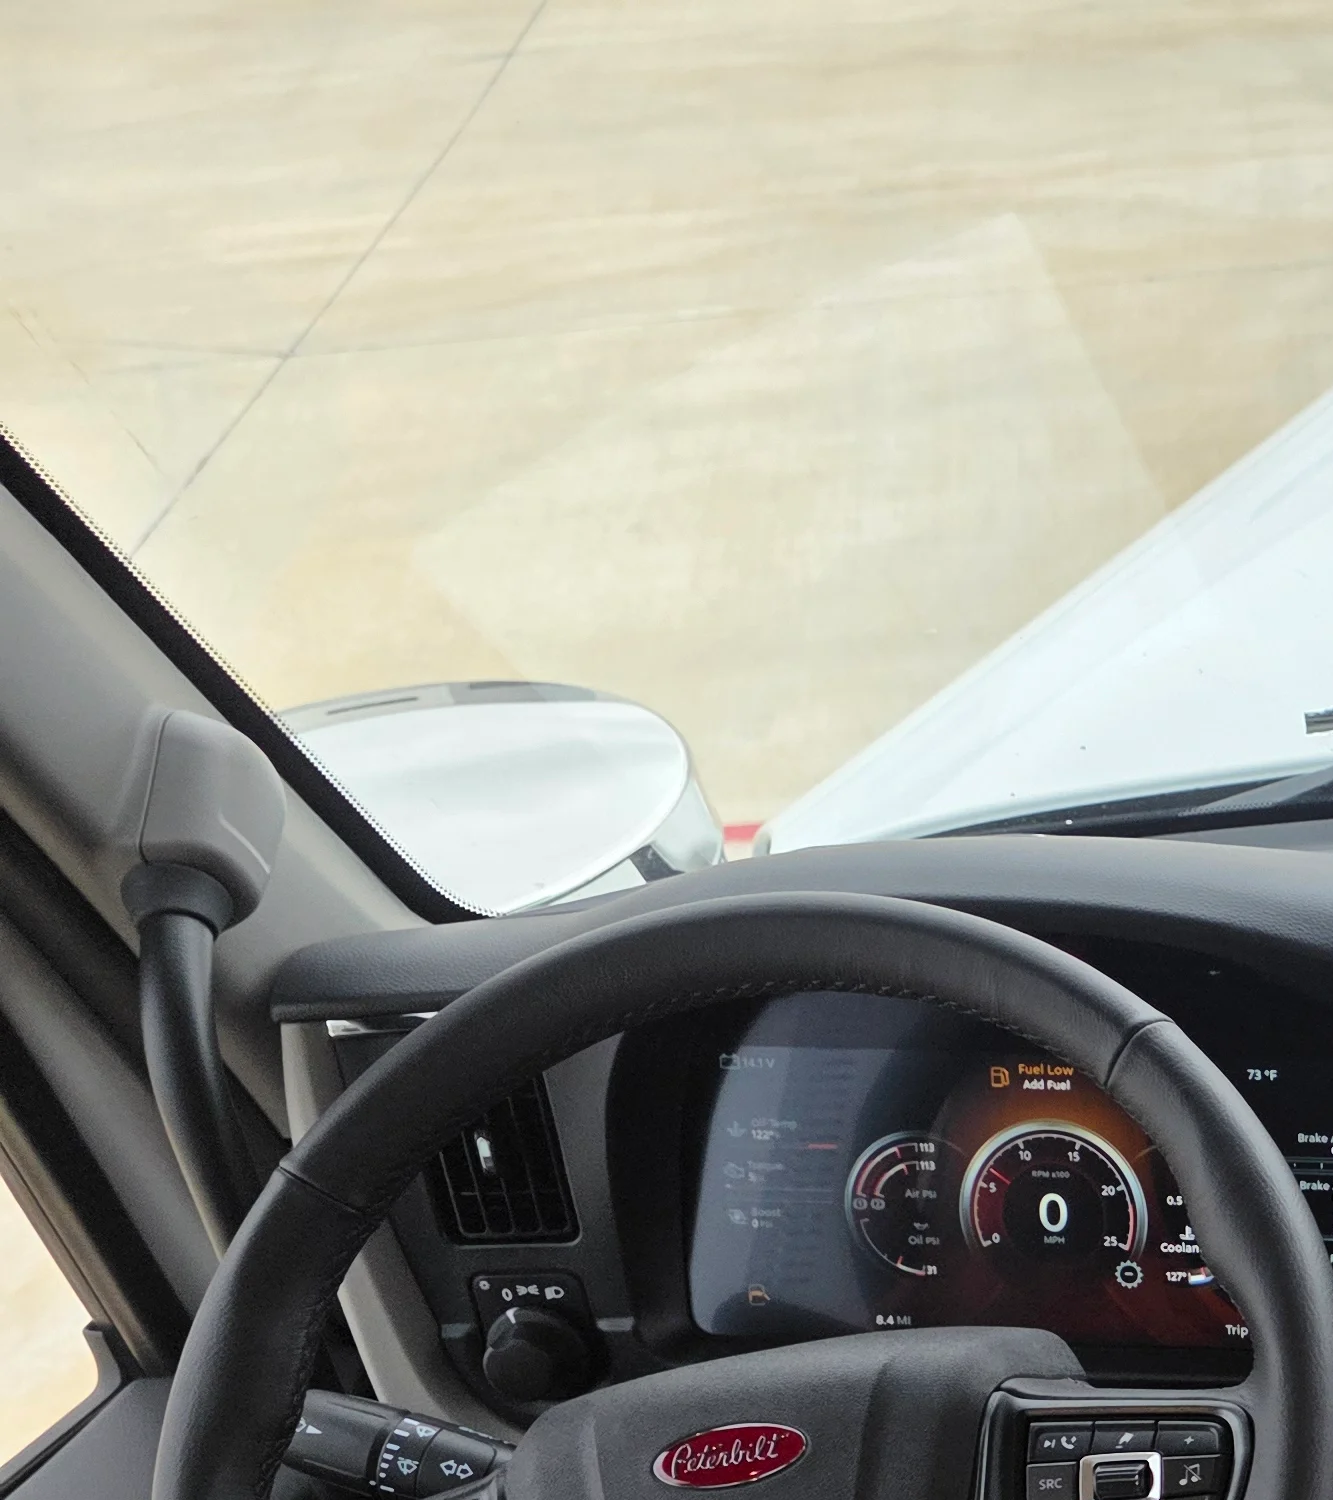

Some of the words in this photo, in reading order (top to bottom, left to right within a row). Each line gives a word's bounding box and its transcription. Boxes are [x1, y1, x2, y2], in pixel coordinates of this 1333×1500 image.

[1018, 1064, 1044, 1076] Fuel
[1047, 1065, 1074, 1076] Low
[1247, 1069, 1261, 1081] 73
[1023, 1079, 1044, 1090] Add
[1047, 1080, 1071, 1091] Fuel
[1297, 1133, 1329, 1143] Brake
[1018, 1151, 1032, 1161] 10
[1067, 1152, 1080, 1162] 15
[989, 1182, 997, 1193] 5
[1101, 1185, 1115, 1196] 20
[1300, 1180, 1330, 1191] Brake
[905, 1189, 919, 1198] Air
[1166, 1195, 1183, 1206] 0.5
[1038, 1192, 1068, 1233] 0
[908, 1235, 923, 1245] Oil
[992, 1233, 1000, 1243] 0
[1103, 1236, 1118, 1247] 25
[1160, 1242, 1200, 1253] Coolan
[876, 1315, 895, 1325] 8.4
[897, 1316, 912, 1325] MI
[1225, 1324, 1249, 1339] Trip
[670, 1433, 790, 1479] Peterbilt
[1038, 1477, 1063, 1491] SRC
